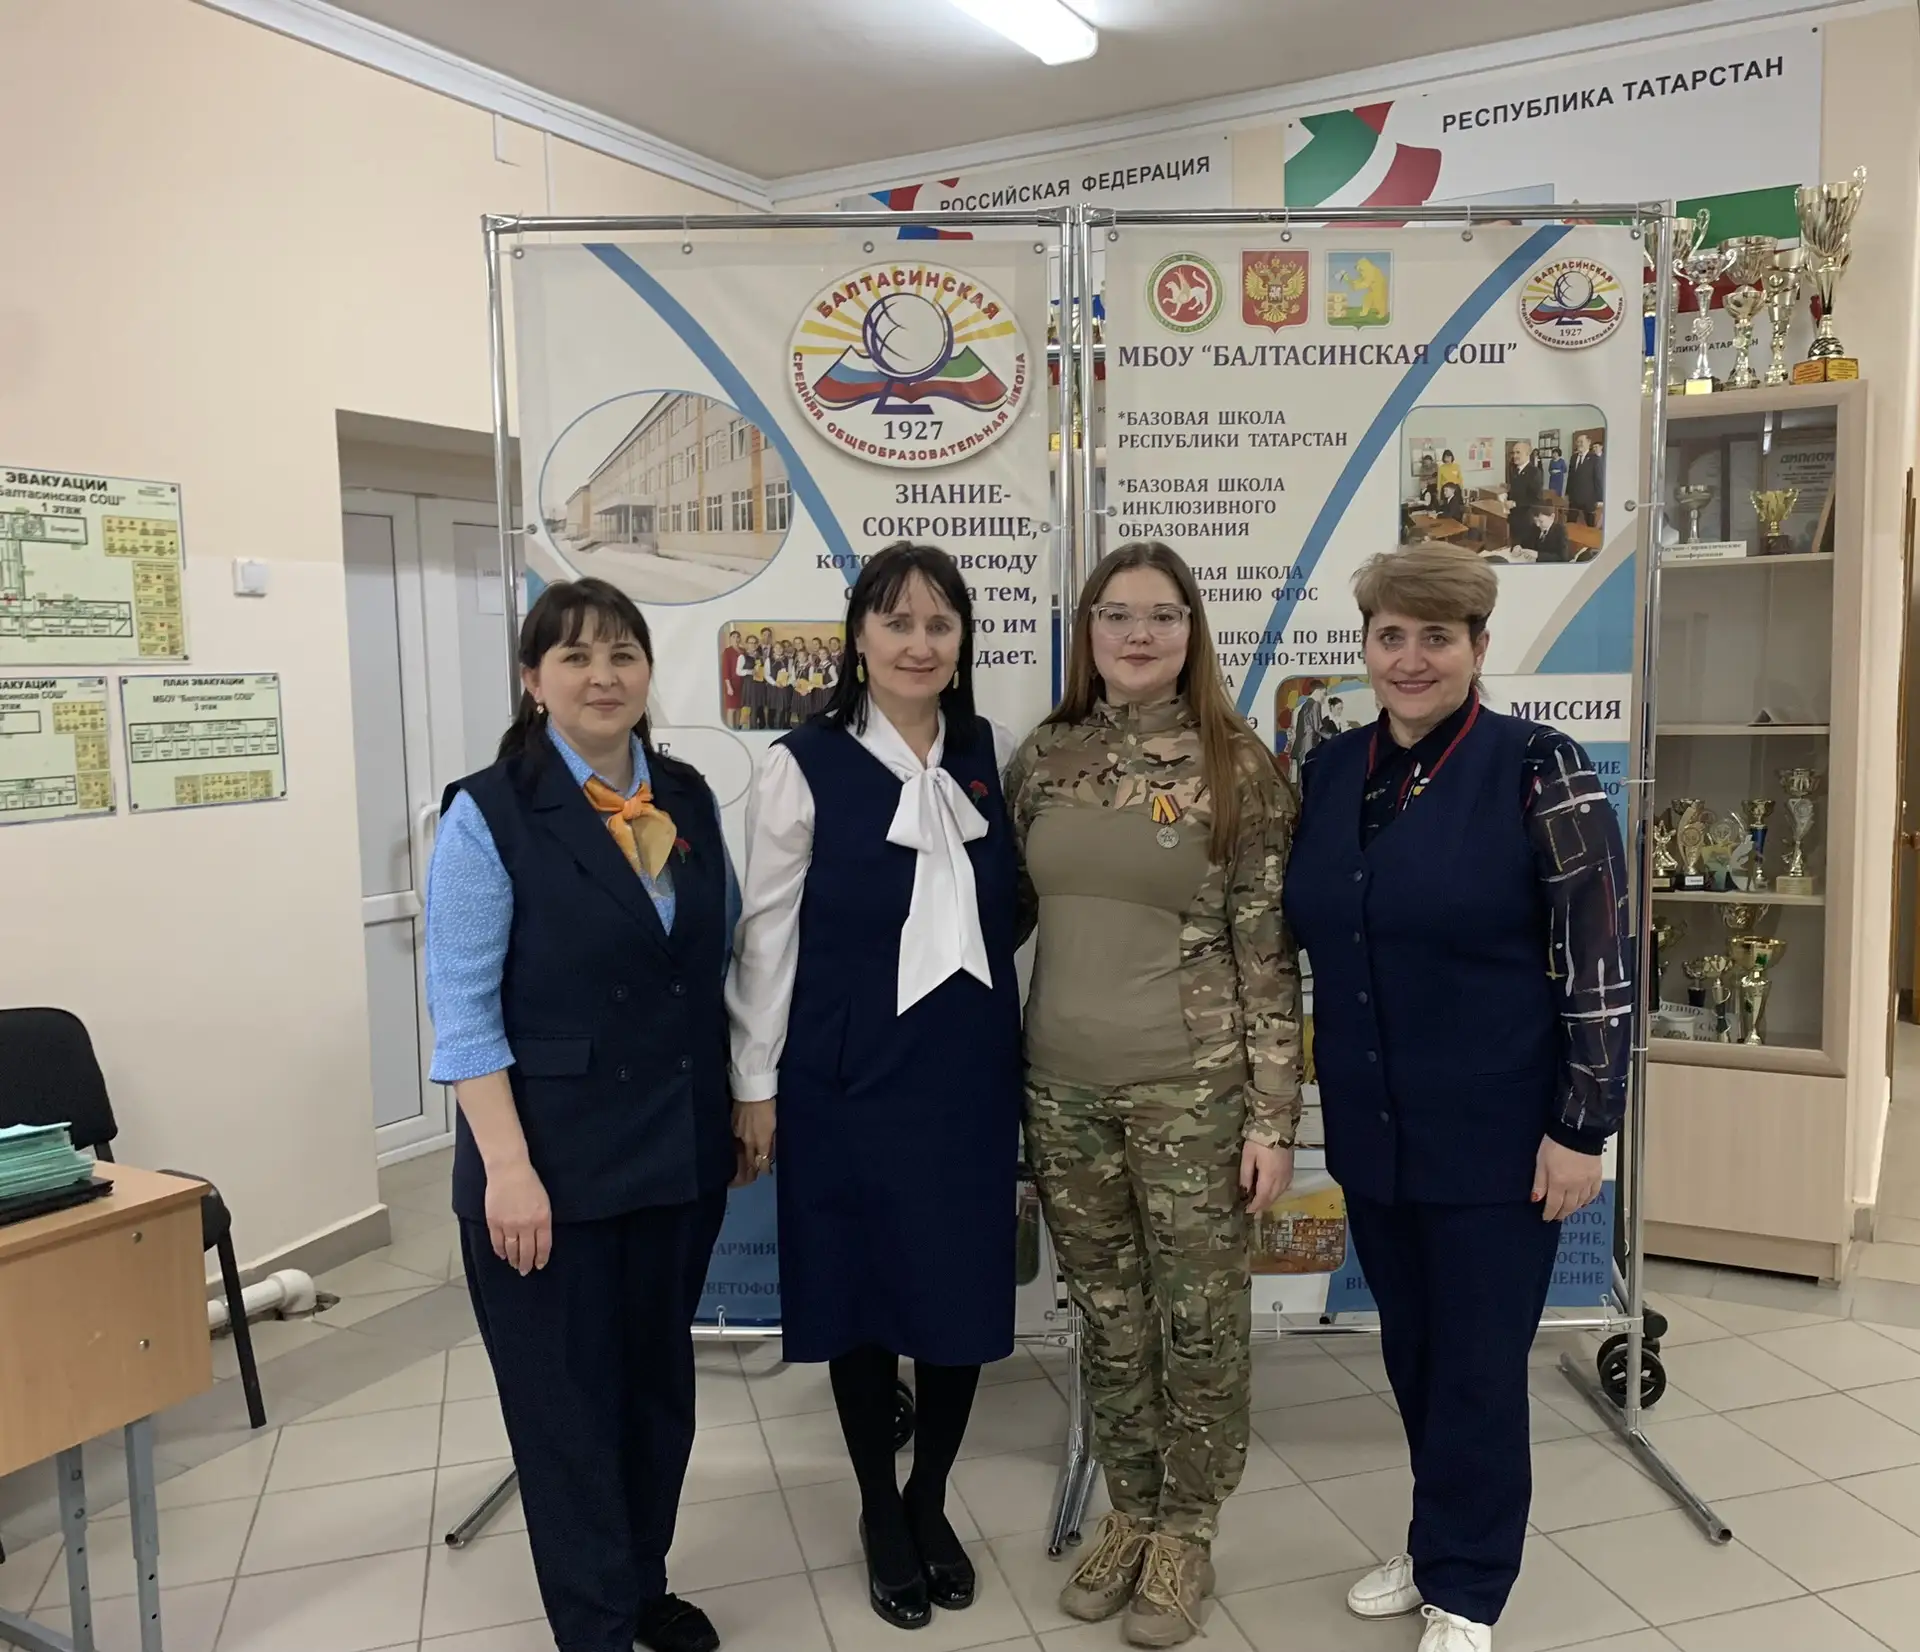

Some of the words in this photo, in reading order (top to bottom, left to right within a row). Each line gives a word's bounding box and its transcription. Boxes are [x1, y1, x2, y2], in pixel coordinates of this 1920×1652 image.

[1442, 86, 1615, 133] РЕСПУБЛИКА
[1622, 56, 1784, 101] ТАТАРСТАН
[939, 179, 1070, 211] РОССИЙСКАЯ
[1081, 156, 1210, 191] ФЕДЕРАЦИЯ
[1533, 260, 1614, 284] БАЛТАСИНСКАЯ
[816, 269, 1001, 320] БАЛТАСИНСКАЯ
[1559, 328, 1582, 337] 1927
[1118, 345, 1194, 367] МБОУ
[1202, 343, 1430, 367] “БАЛТАСИНСКАЯ
[1443, 342, 1518, 364] СОШ”
[793, 352, 824, 421] СРЕДНЯЯ
[827, 410, 1009, 461] ОБЩЕОБРАЗОВАТЕЛЬНАЯ
[1006, 353, 1026, 408] ШКОЛА
[1218, 410, 1286, 425] ШКОЛА
[884, 420, 944, 440] 1927
[1118, 433, 1239, 449] РЕСПУБЛИКИ
[1248, 432, 1348, 448] ТАТАРСТАН
[5, 471, 108, 492] ЭВАКУАЦИИ
[1218, 477, 1286, 493] ШКОЛА
[895, 483, 1012, 504] ЗНАНИЕ-
[42, 502, 48, 513] 1
[52, 505, 82, 515] этаж
[1122, 499, 1277, 516] ИНКЛЮЗИВНОГО
[862, 516, 1038, 541] СОКРОВИЩЕ,
[1118, 521, 1250, 538] ОБРАЗОВАНИЯ
[816, 553, 870, 570] кото
[952, 553, 1038, 574] овсюду
[1191, 566, 1228, 580] НАЯ
[1236, 565, 1305, 581] ШКОЛА
[985, 586, 1038, 605] тем,
[1199, 587, 1263, 602] РЕНИЮ
[1271, 586, 1319, 602] ФГОС
[1003, 618, 1037, 634] им
[1217, 630, 1285, 645] ШКОЛА
[1293, 630, 1318, 644] ПО
[1327, 629, 1363, 644] ВНЕ
[975, 650, 1038, 668] дает.
[1217, 651, 1367, 667] НАУЧНО-ТЕХНИЧ
[163, 678, 189, 687] ПЛАН
[192, 677, 245, 687] ЭВАКУАЦИИ
[1510, 700, 1621, 720] МИССИЯ
[715, 1241, 776, 1256] АРМИЯ
[1556, 1250, 1604, 1266] ОСТЬ,
[702, 1281, 780, 1296] ВЕТОФО
